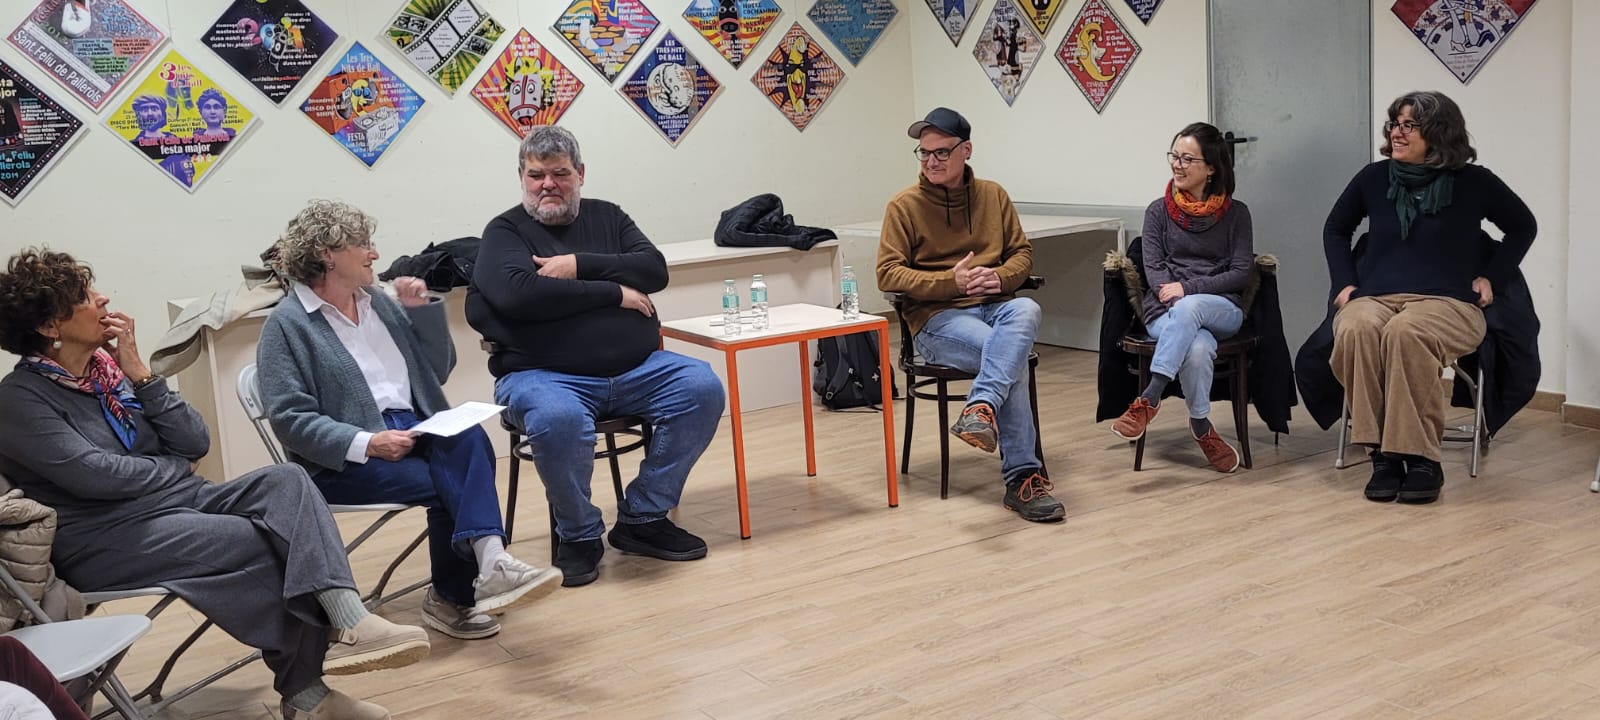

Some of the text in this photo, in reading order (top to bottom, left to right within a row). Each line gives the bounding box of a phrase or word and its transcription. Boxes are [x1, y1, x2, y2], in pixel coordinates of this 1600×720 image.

[13, 30, 103, 104] Sant Feliu de Pallerols
[160, 142, 211, 155] festa major
